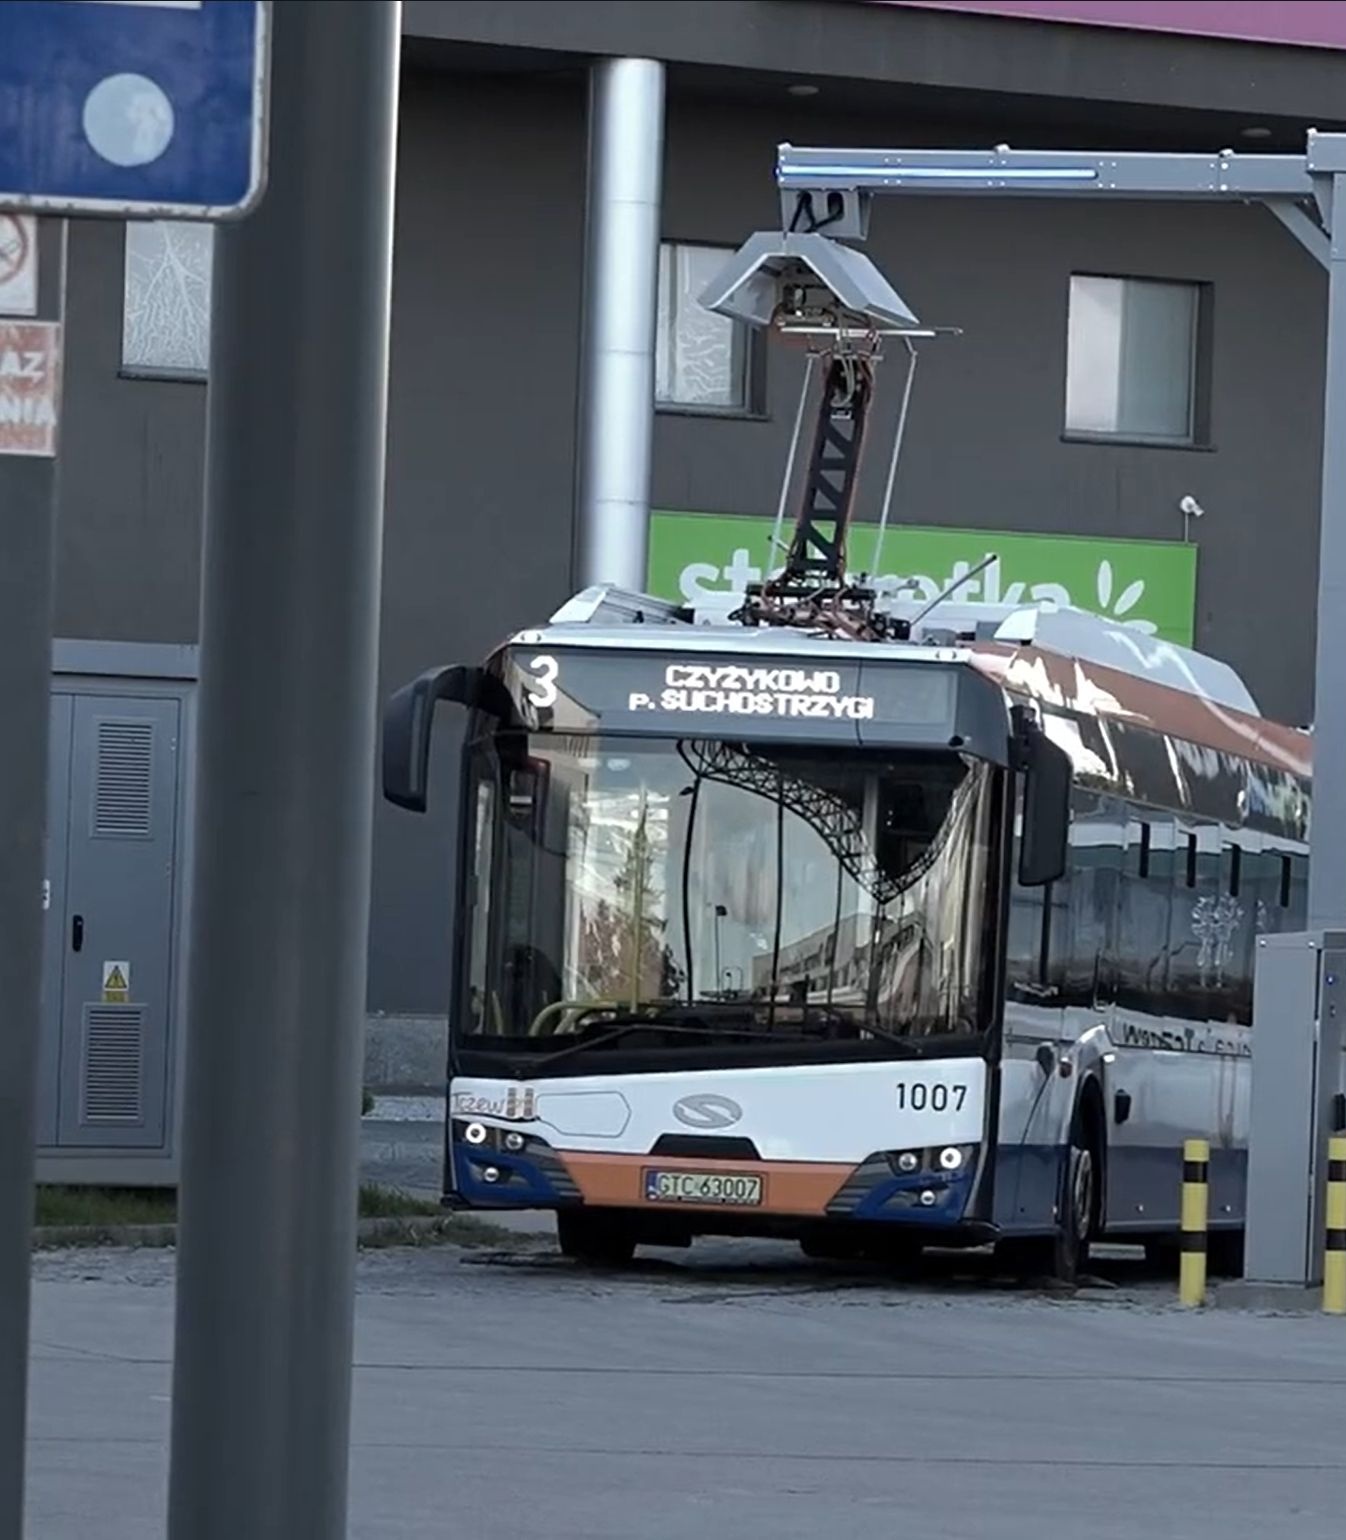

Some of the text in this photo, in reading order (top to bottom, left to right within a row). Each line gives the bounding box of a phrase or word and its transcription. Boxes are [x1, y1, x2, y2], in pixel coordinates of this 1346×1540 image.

[528, 656, 559, 707] 3
[665, 665, 840, 693] CZYŻYKOWO
[661, 689, 874, 718] SUCHOSTRZYGI
[453, 1092, 505, 1114] Tczew
[896, 1083, 967, 1111] 1007
[659, 1174, 757, 1198] GTC 63007
